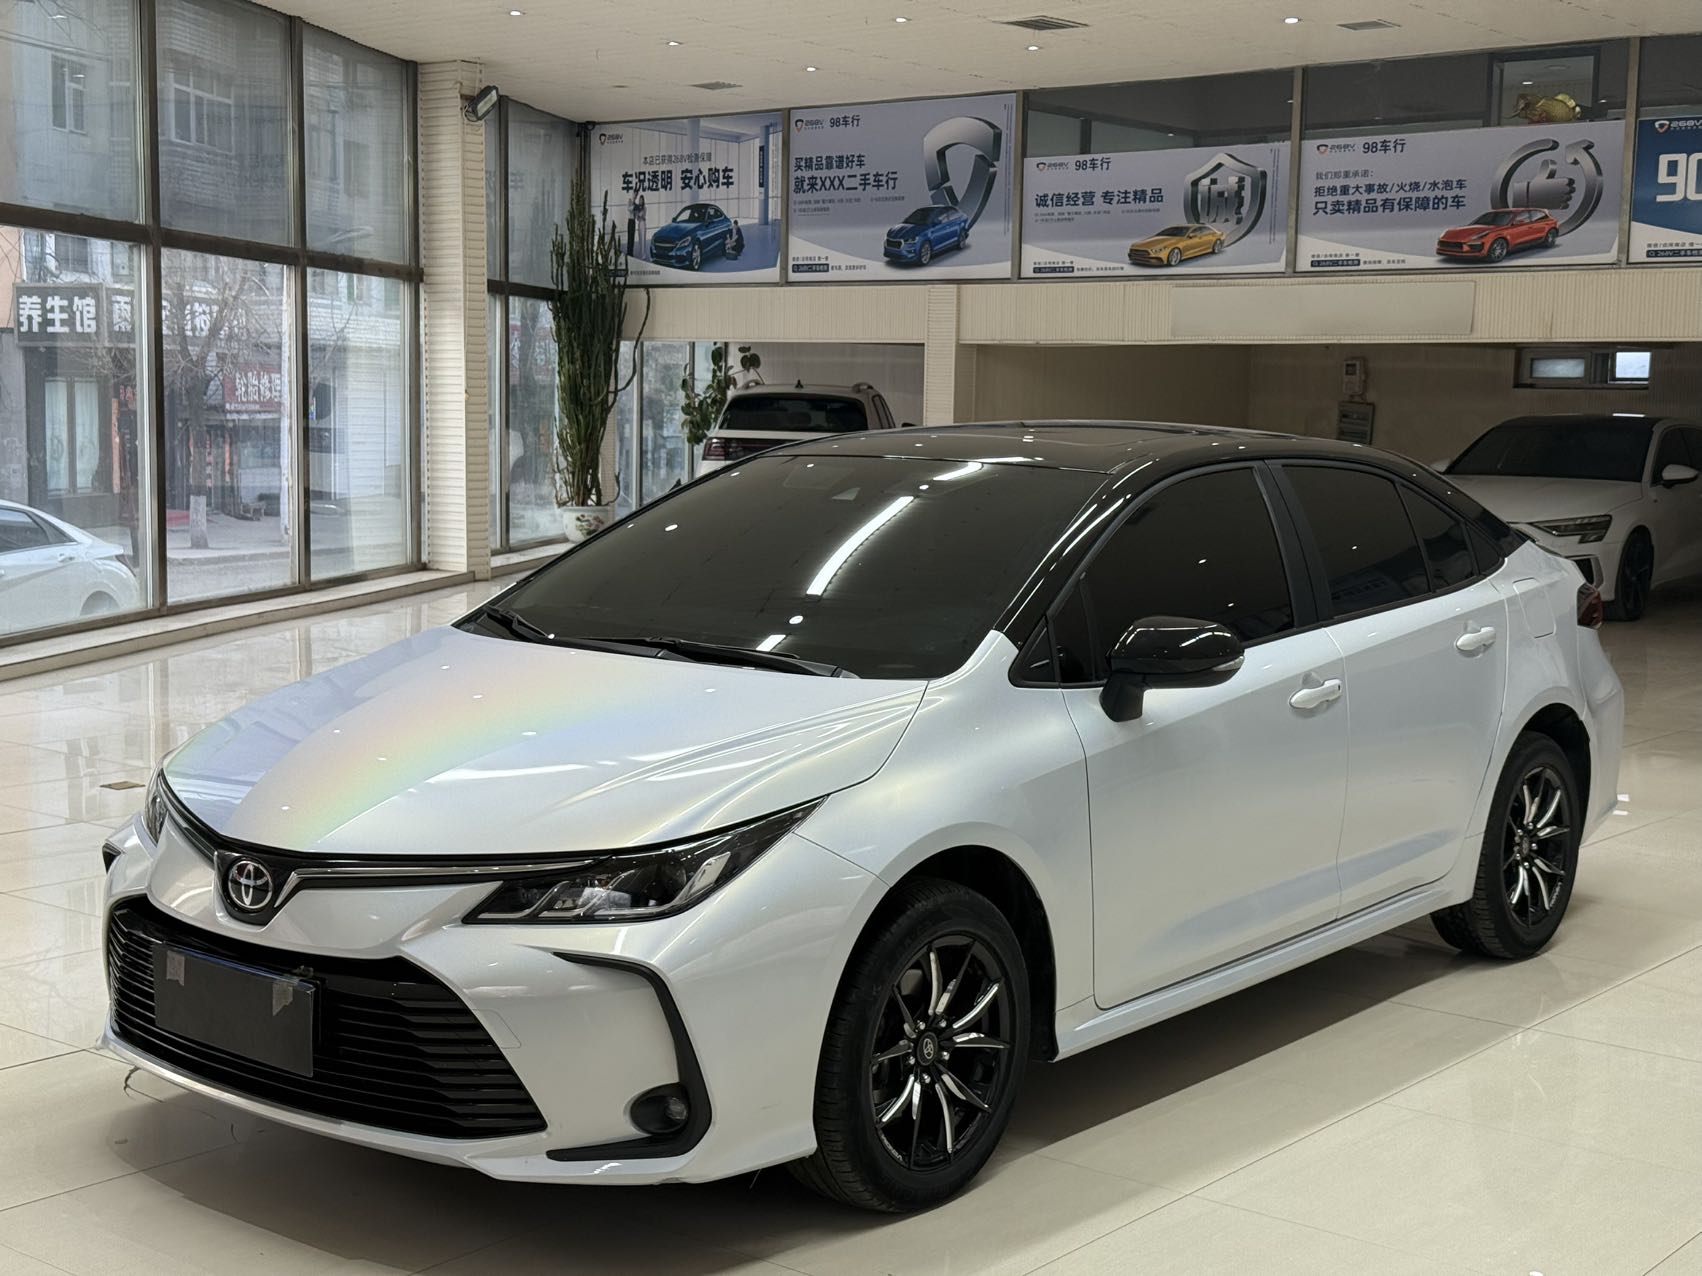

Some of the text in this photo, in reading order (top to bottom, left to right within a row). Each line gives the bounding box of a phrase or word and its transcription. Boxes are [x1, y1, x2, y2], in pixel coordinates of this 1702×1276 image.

[829, 114, 861, 128] 98车行
[1362, 138, 1407, 154] 98车行
[793, 153, 866, 173] 买精品靠谱好车
[1074, 157, 1112, 171] 98车行
[621, 166, 735, 193] 车况透明 安心购车
[793, 171, 898, 194] 就来XXX二手车行
[1313, 179, 1467, 198] 拒绝重大事故/火烧/水泡车
[1035, 187, 1164, 208] 诚信经营 专注精品
[1312, 194, 1467, 216] 只卖精品有保障的车
[19, 295, 97, 333] 养生馆
